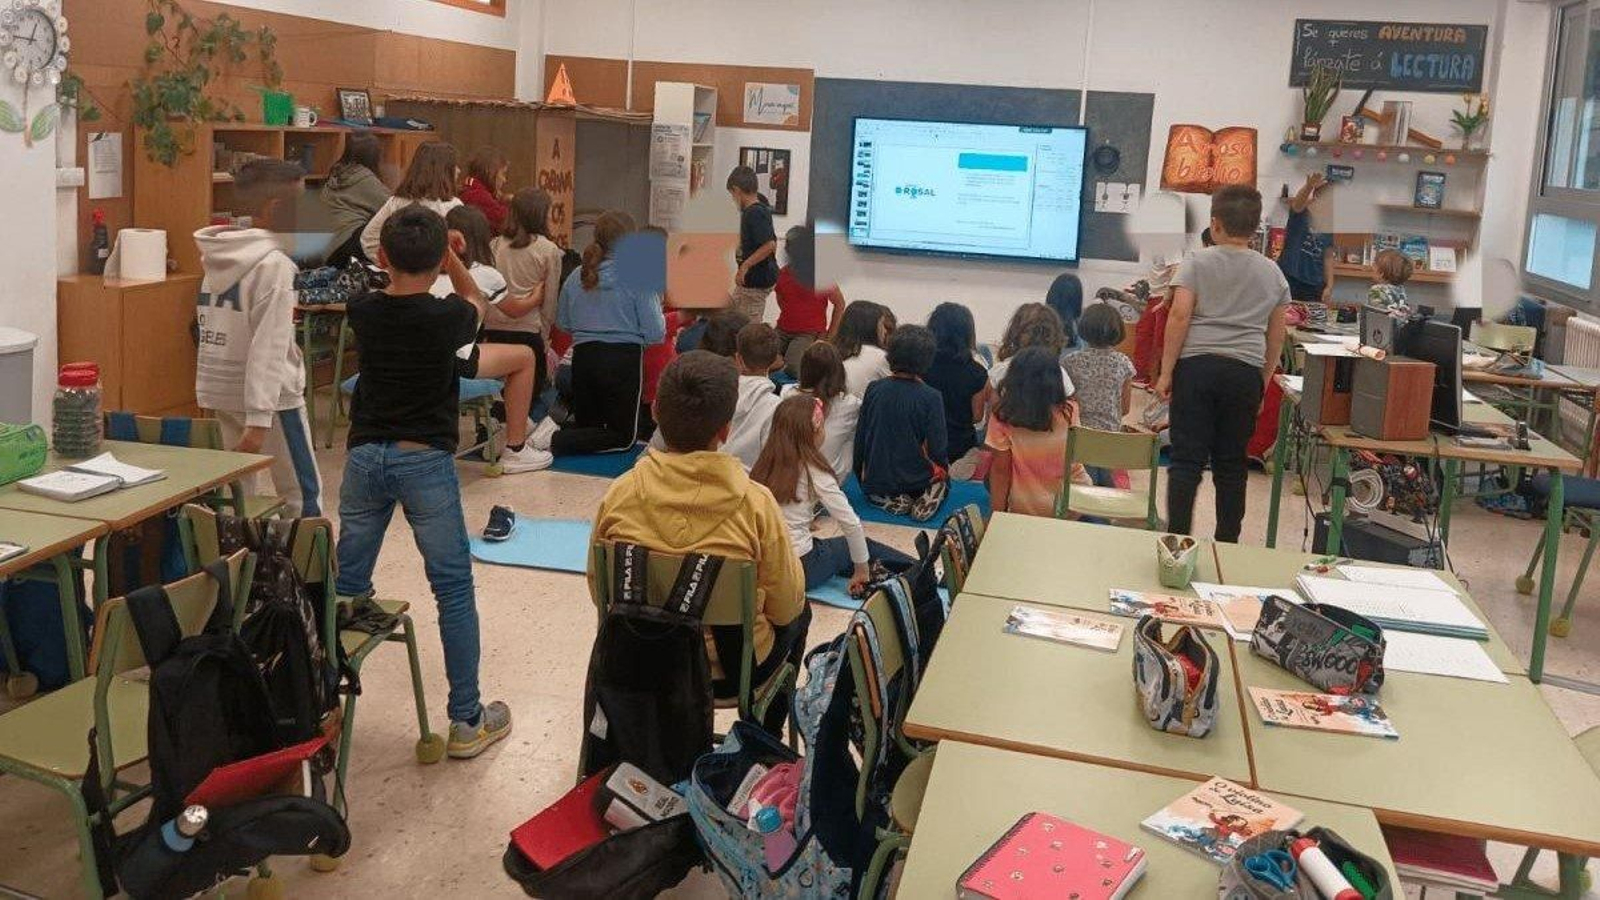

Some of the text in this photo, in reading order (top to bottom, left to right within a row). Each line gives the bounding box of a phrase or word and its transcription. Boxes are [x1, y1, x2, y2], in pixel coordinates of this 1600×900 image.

[1377, 25, 1467, 45] AVENTURA
[1390, 52, 1475, 81] LECTURA
[683, 581, 698, 603] FILA
